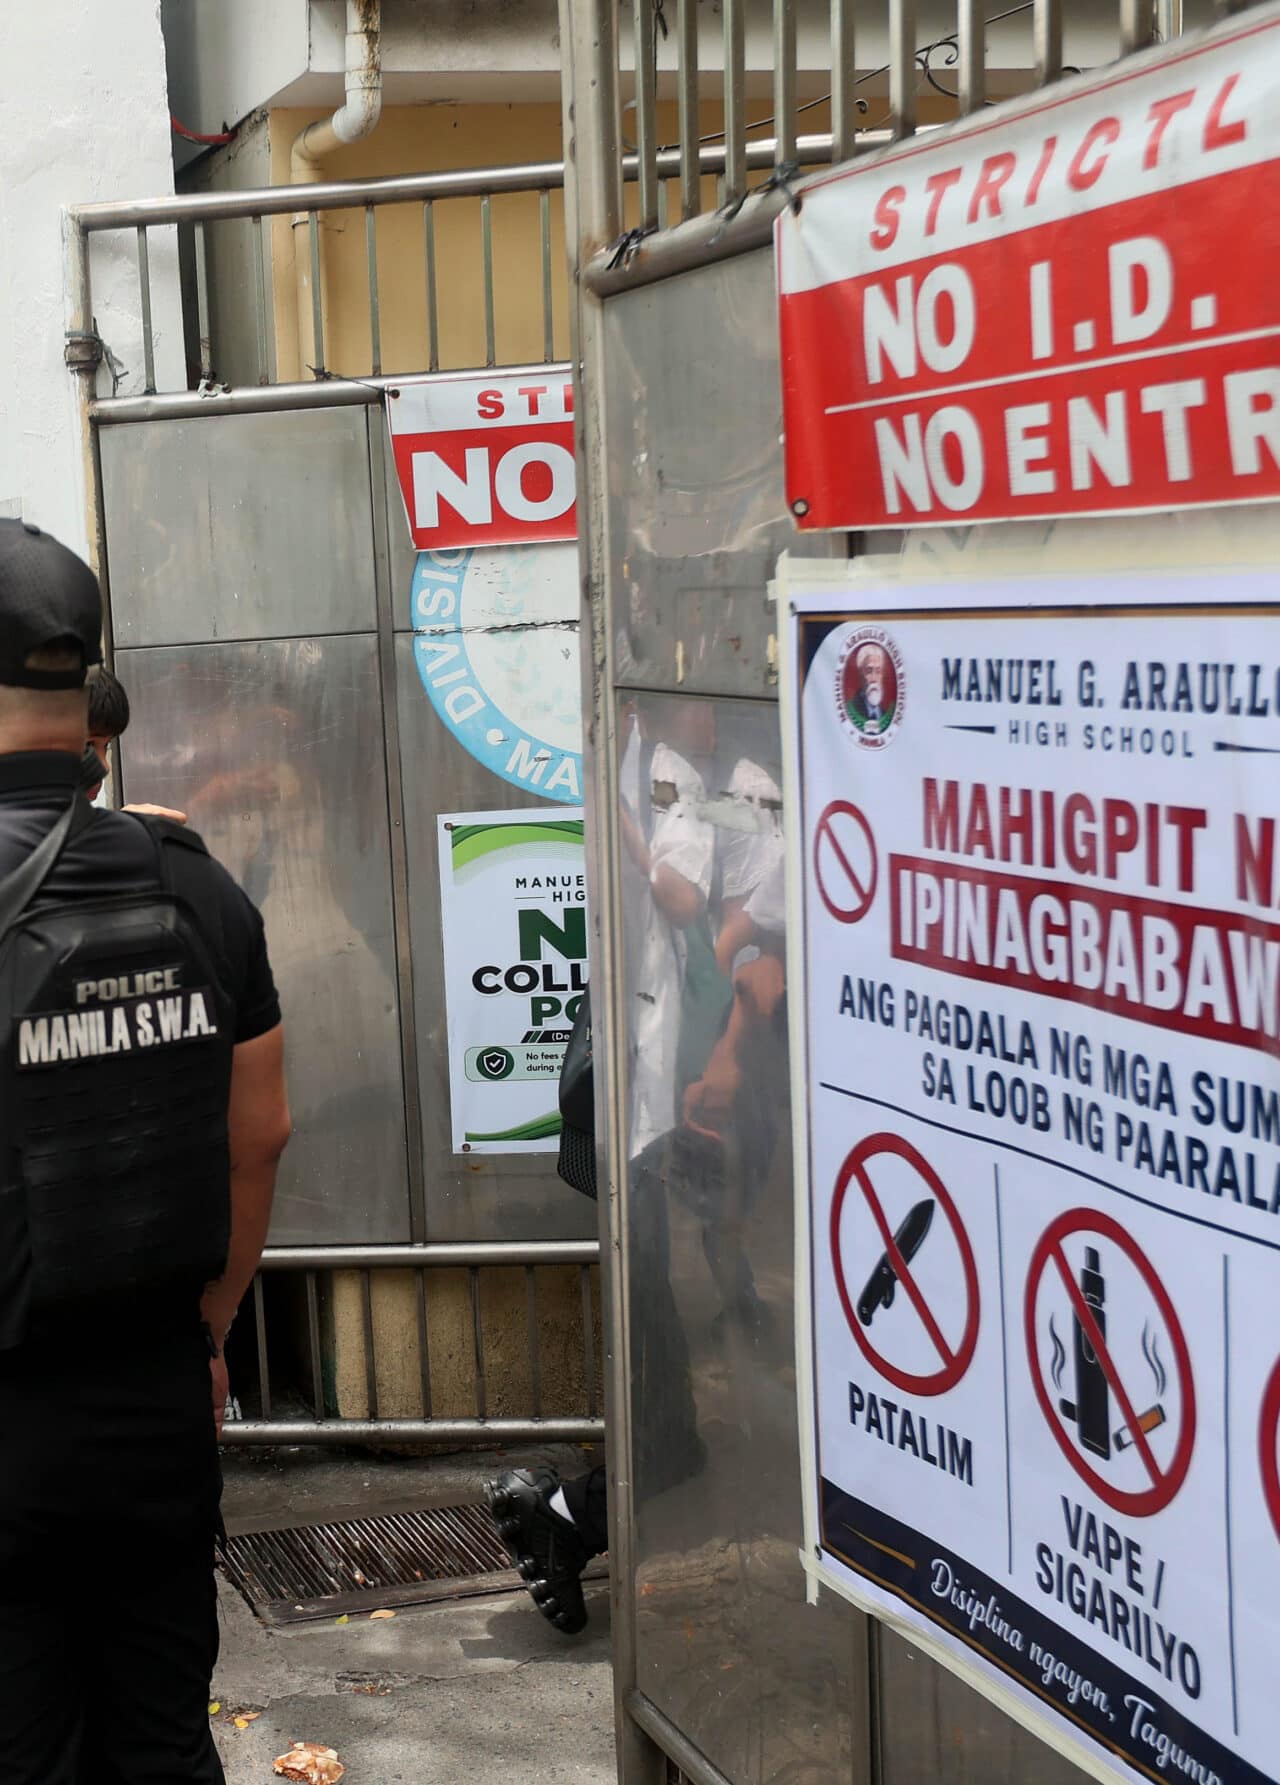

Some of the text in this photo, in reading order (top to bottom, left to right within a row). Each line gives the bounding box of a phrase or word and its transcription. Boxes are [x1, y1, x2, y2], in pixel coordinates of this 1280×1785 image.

[870, 72, 1246, 252] STRICTL
[863, 236, 1217, 385] NO I.D.
[412, 441, 577, 529] NO
[875, 366, 1280, 515] NO ENTR
[941, 658, 1280, 718] MANUEL G. ARAULL
[1008, 720, 1194, 758] HIGH SCHOOL
[516, 875, 585, 889] MANUE
[923, 777, 1280, 909] MAHIGPIT N
[518, 907, 588, 961] N
[553, 890, 586, 902] HIG
[76, 967, 181, 1004] POLICE
[472, 963, 589, 994] COLL
[898, 868, 1280, 1040] IPINAGBABAW
[20, 992, 217, 1065] MANILA S.W.A.
[526, 1052, 539, 1060] No
[541, 1052, 559, 1060] fees
[526, 1064, 555, 1073] during
[839, 974, 1280, 1147] ANG PAGDALA NG MGA SUM
[921, 1051, 955, 1111] SA
[966, 1064, 1051, 1133] LOOB
[1062, 1092, 1104, 1154] NG
[847, 1381, 975, 1486] PATALIM
[1060, 1495, 1145, 1597] VAPE
[930, 1557, 1024, 1652] Disiplina
[1028, 1641, 1117, 1723] ngayon,
[1034, 1542, 1203, 1700] SIGARILYO
